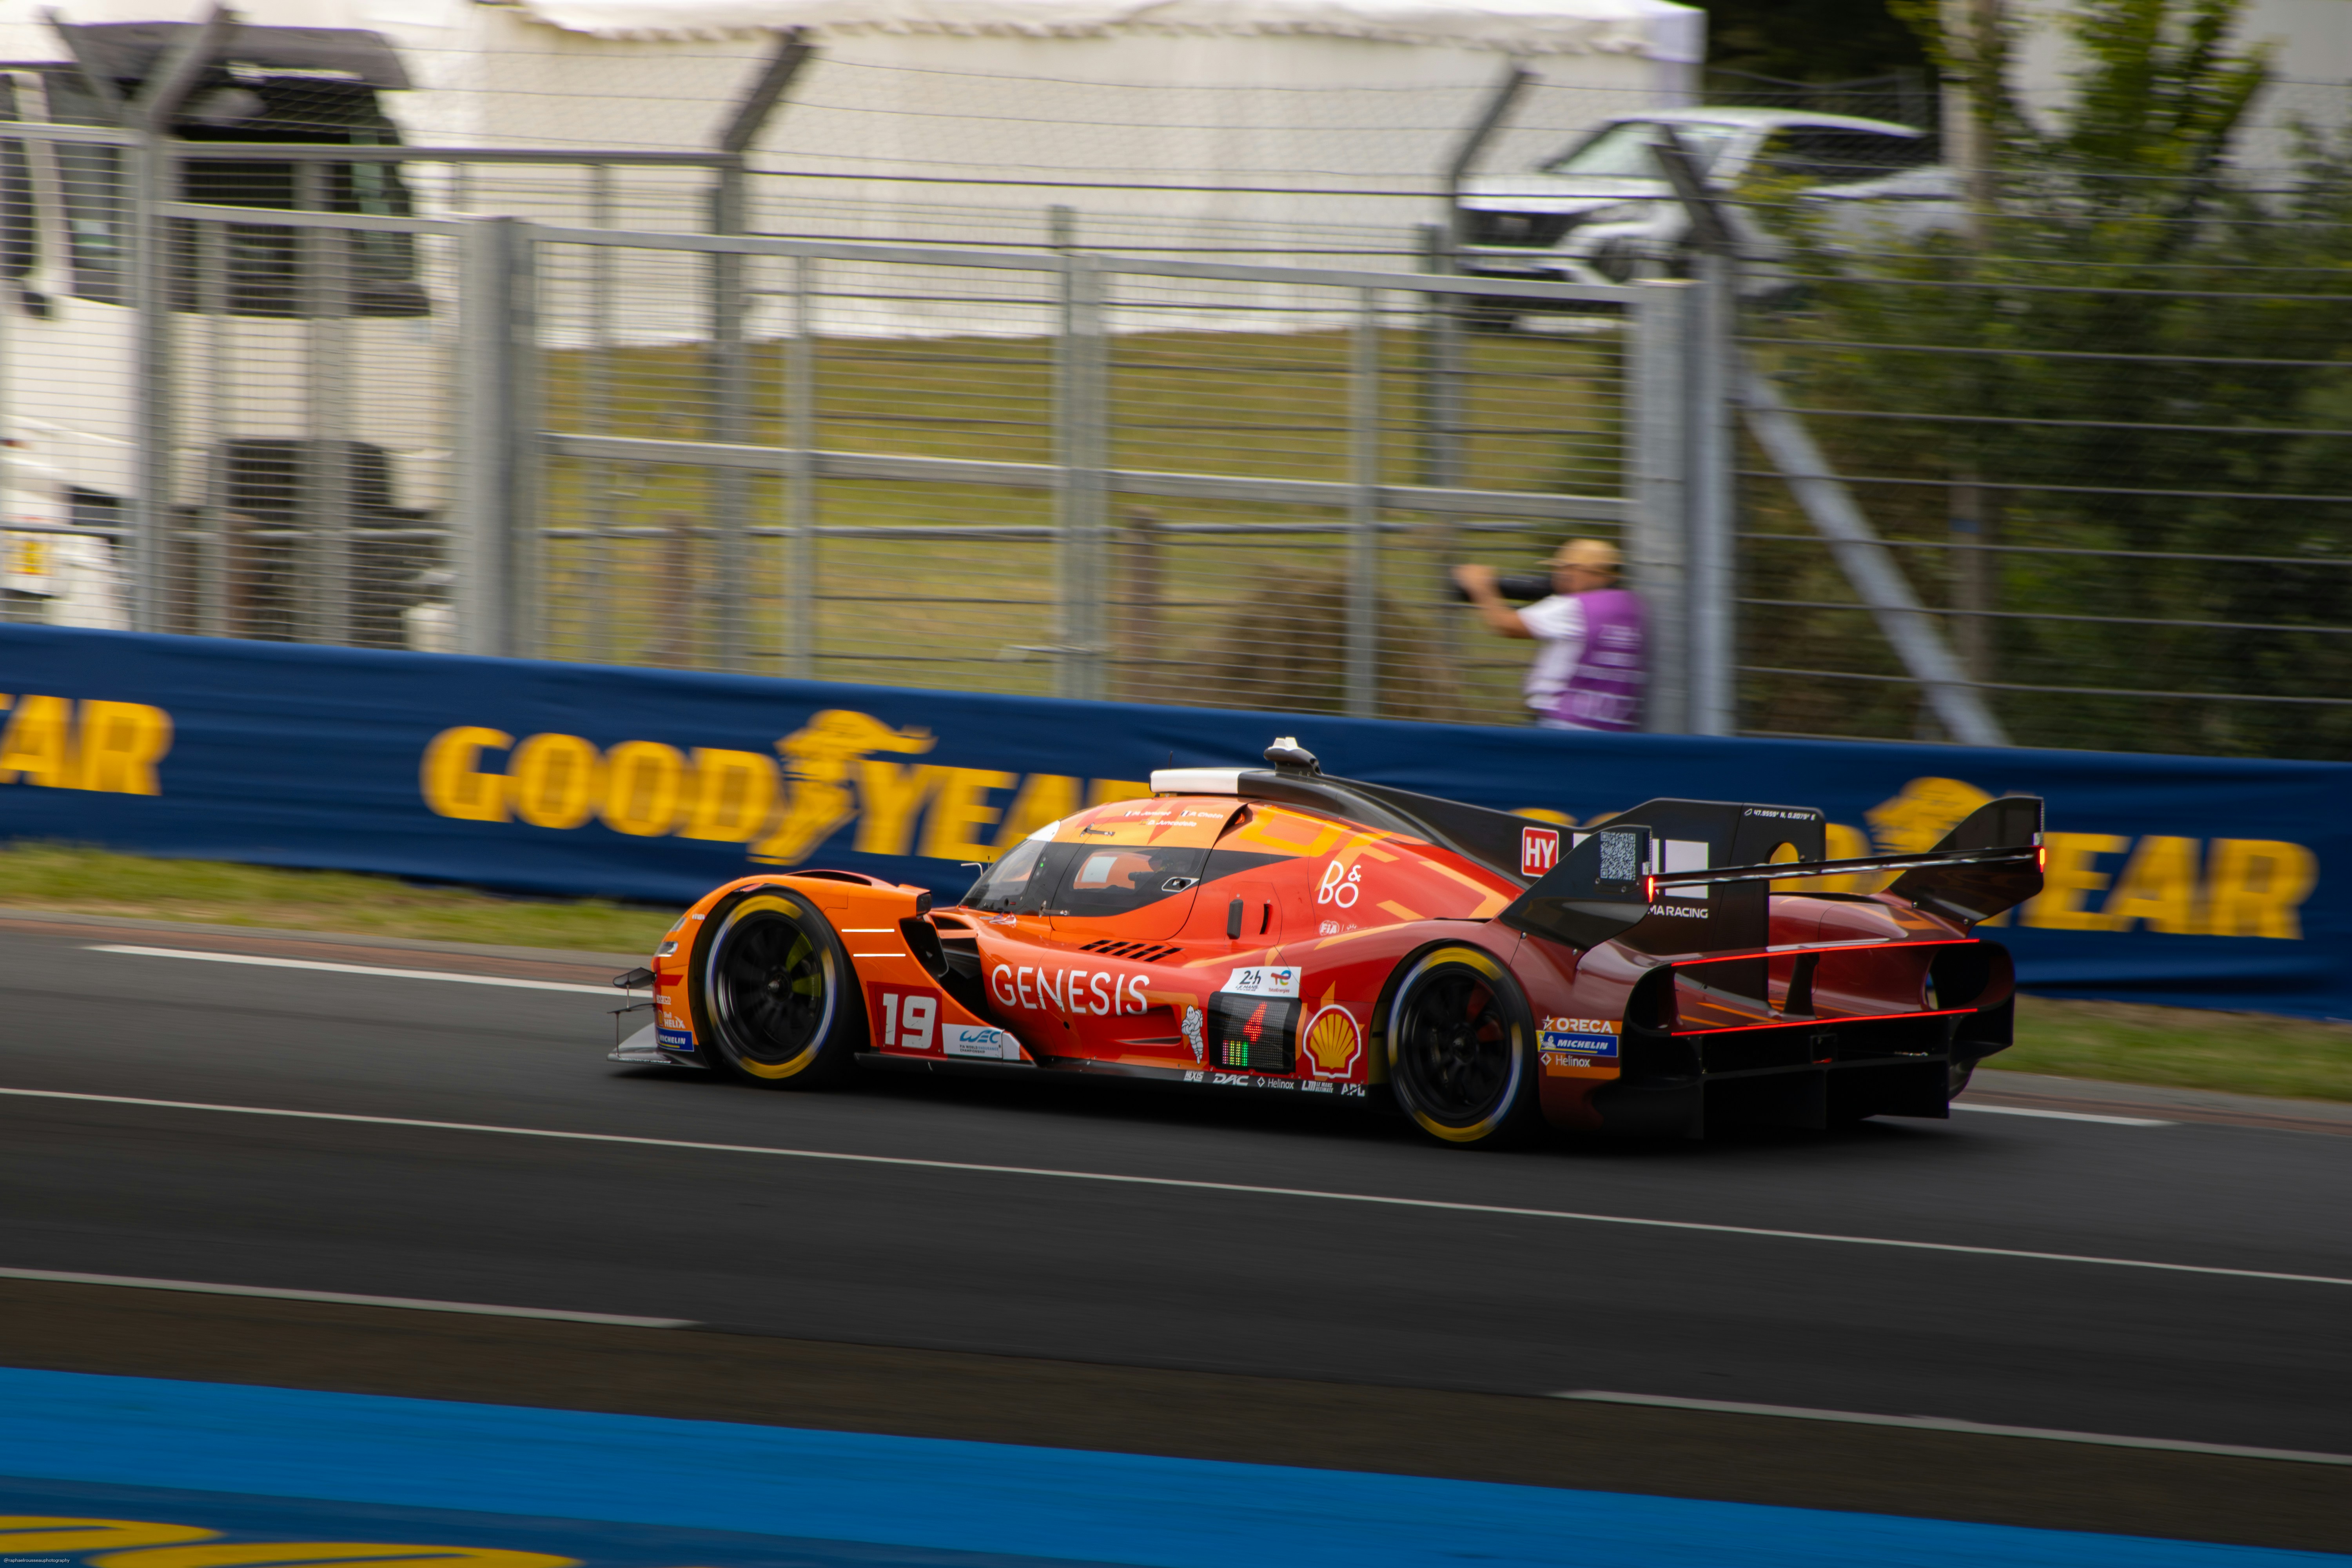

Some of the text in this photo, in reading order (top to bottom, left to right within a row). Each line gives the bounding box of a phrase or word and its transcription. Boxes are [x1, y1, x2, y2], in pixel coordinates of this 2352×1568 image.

[1525, 837, 1556, 869] HY
[1648, 904, 1709, 919] MA RACING
[1319, 923, 1337, 935] FIA
[992, 964, 1150, 1016] GENESIS
[664, 1016, 686, 1029] HELIX
[882, 993, 937, 1049] 19
[1556, 1017, 1613, 1034] ORECA
[659, 1034, 686, 1045] MICHELIN
[959, 1029, 1002, 1044] WEC
[1557, 1039, 1609, 1050] MICHELIN
[1555, 1054, 1591, 1067] Helinox
[1212, 1073, 1250, 1087] DAC
[1267, 1078, 1294, 1089] Helinox
